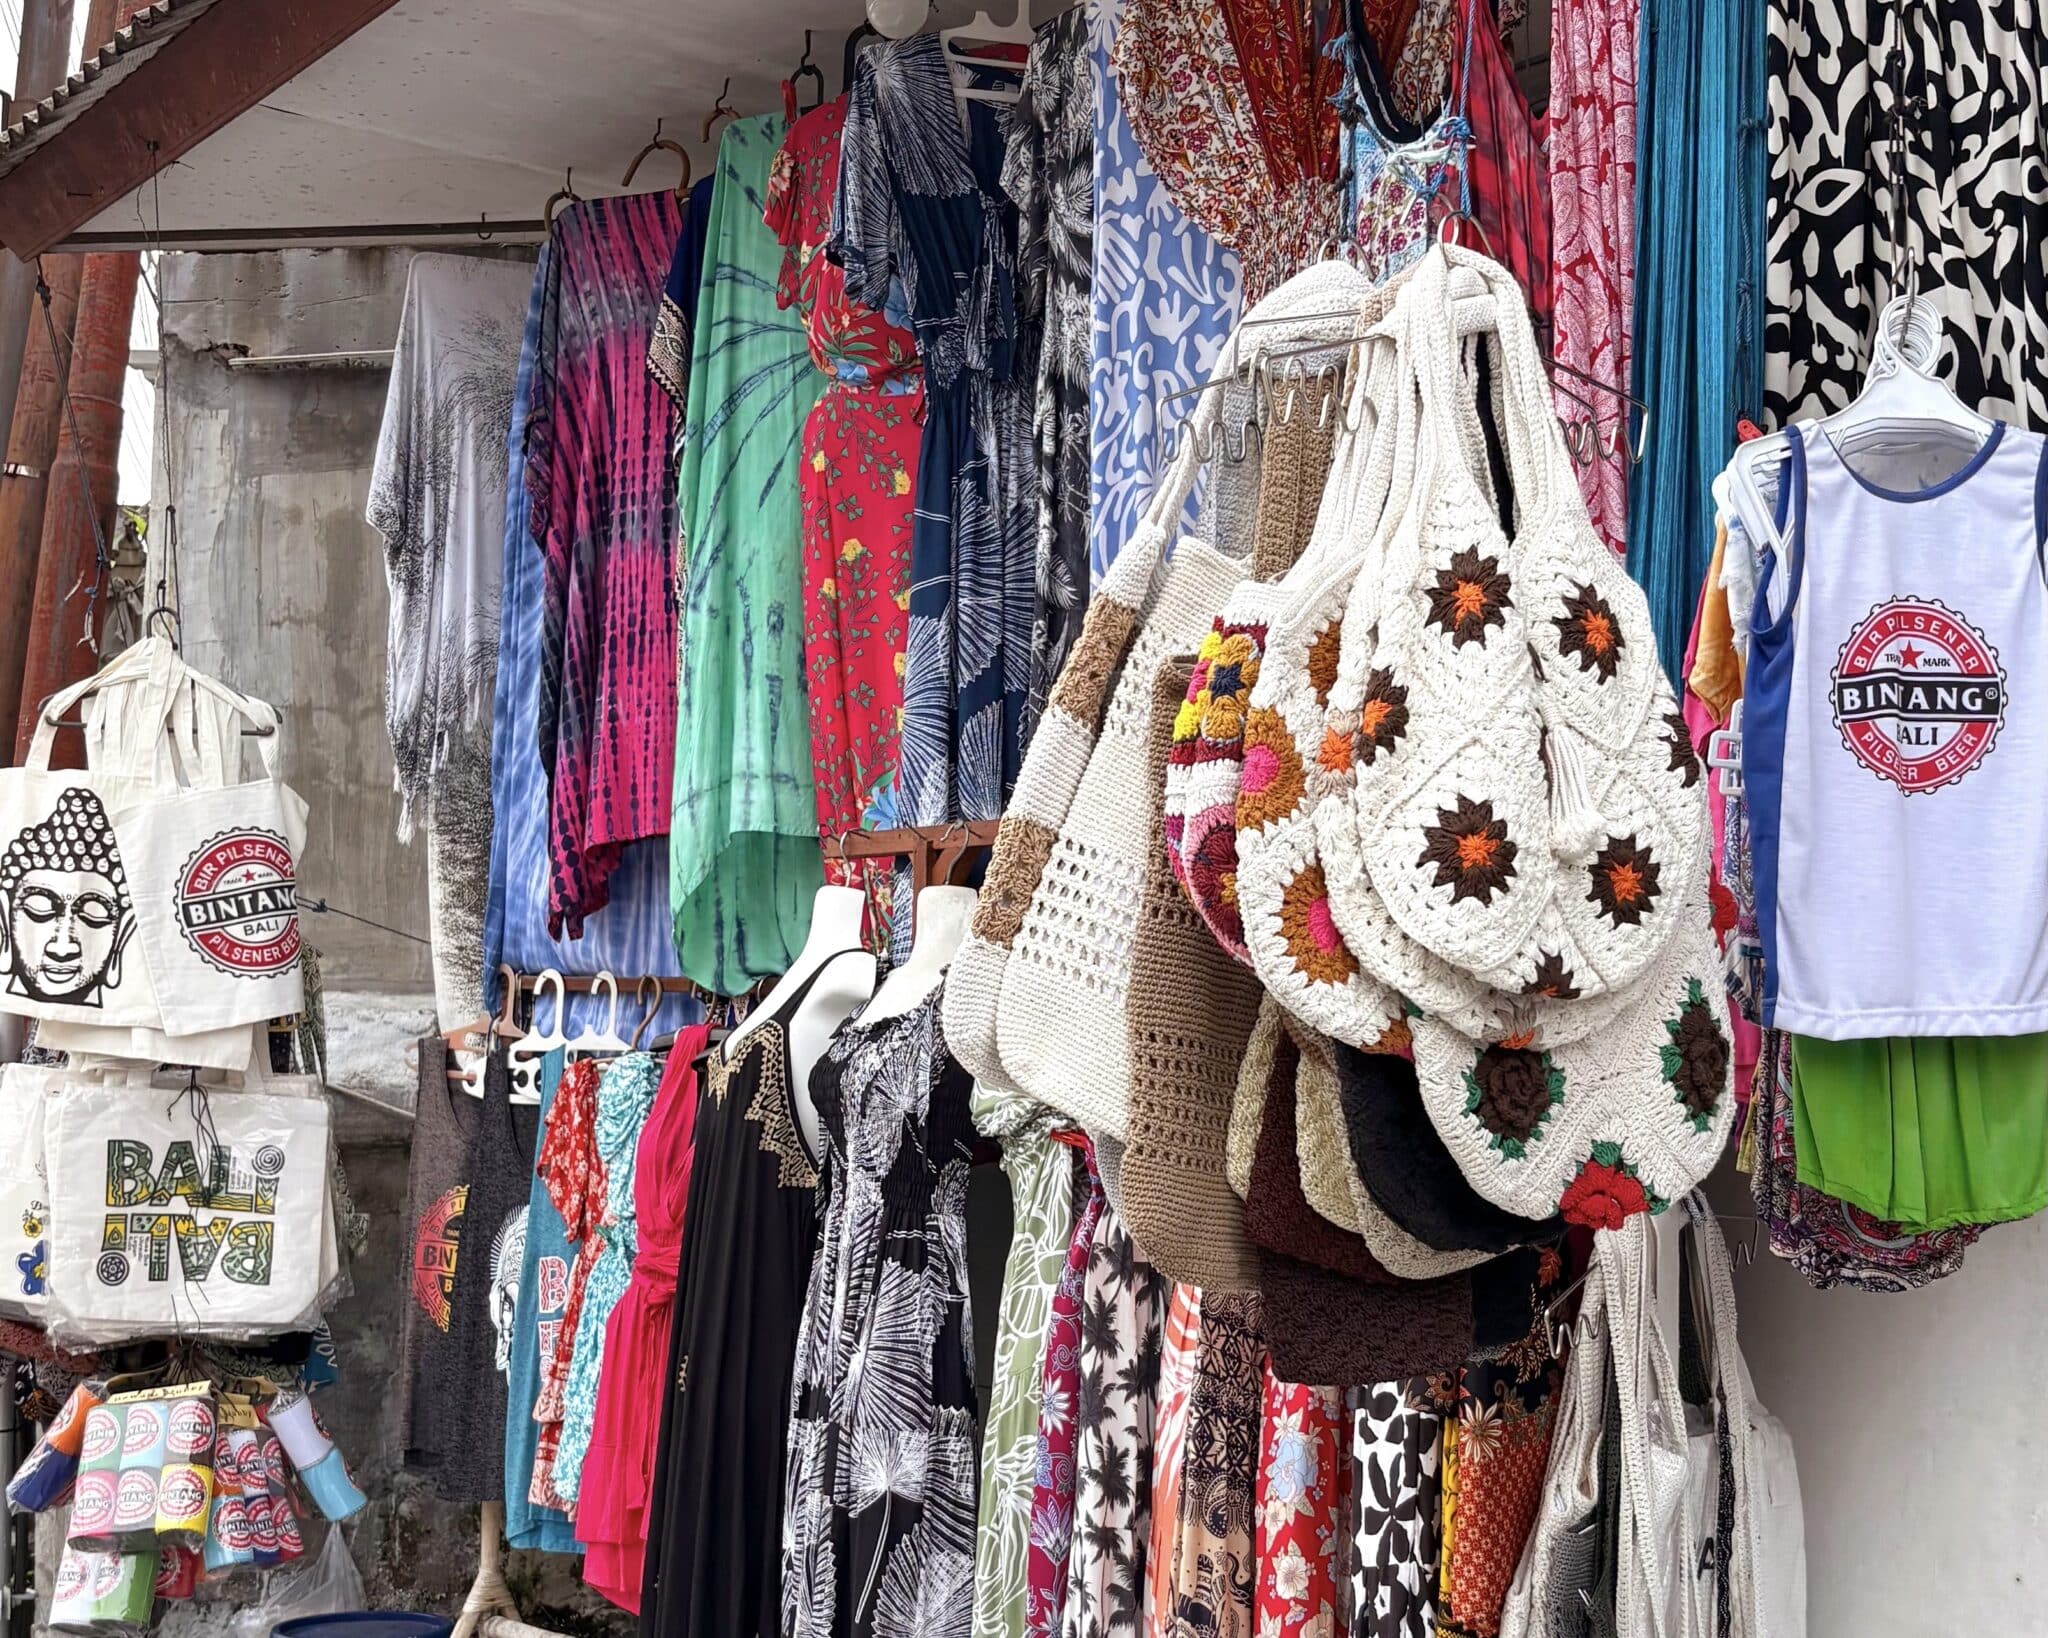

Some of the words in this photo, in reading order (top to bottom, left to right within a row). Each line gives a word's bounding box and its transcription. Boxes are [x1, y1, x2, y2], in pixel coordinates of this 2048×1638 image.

[1853, 629, 1884, 669] BIR
[1897, 723, 1939, 746] ALI
[1934, 732, 1978, 773] BEER
[193, 862, 219, 891] BIR
[215, 843, 294, 877] PILSENER
[243, 919, 280, 937] BALI
[208, 935, 282, 963] PILSENER
